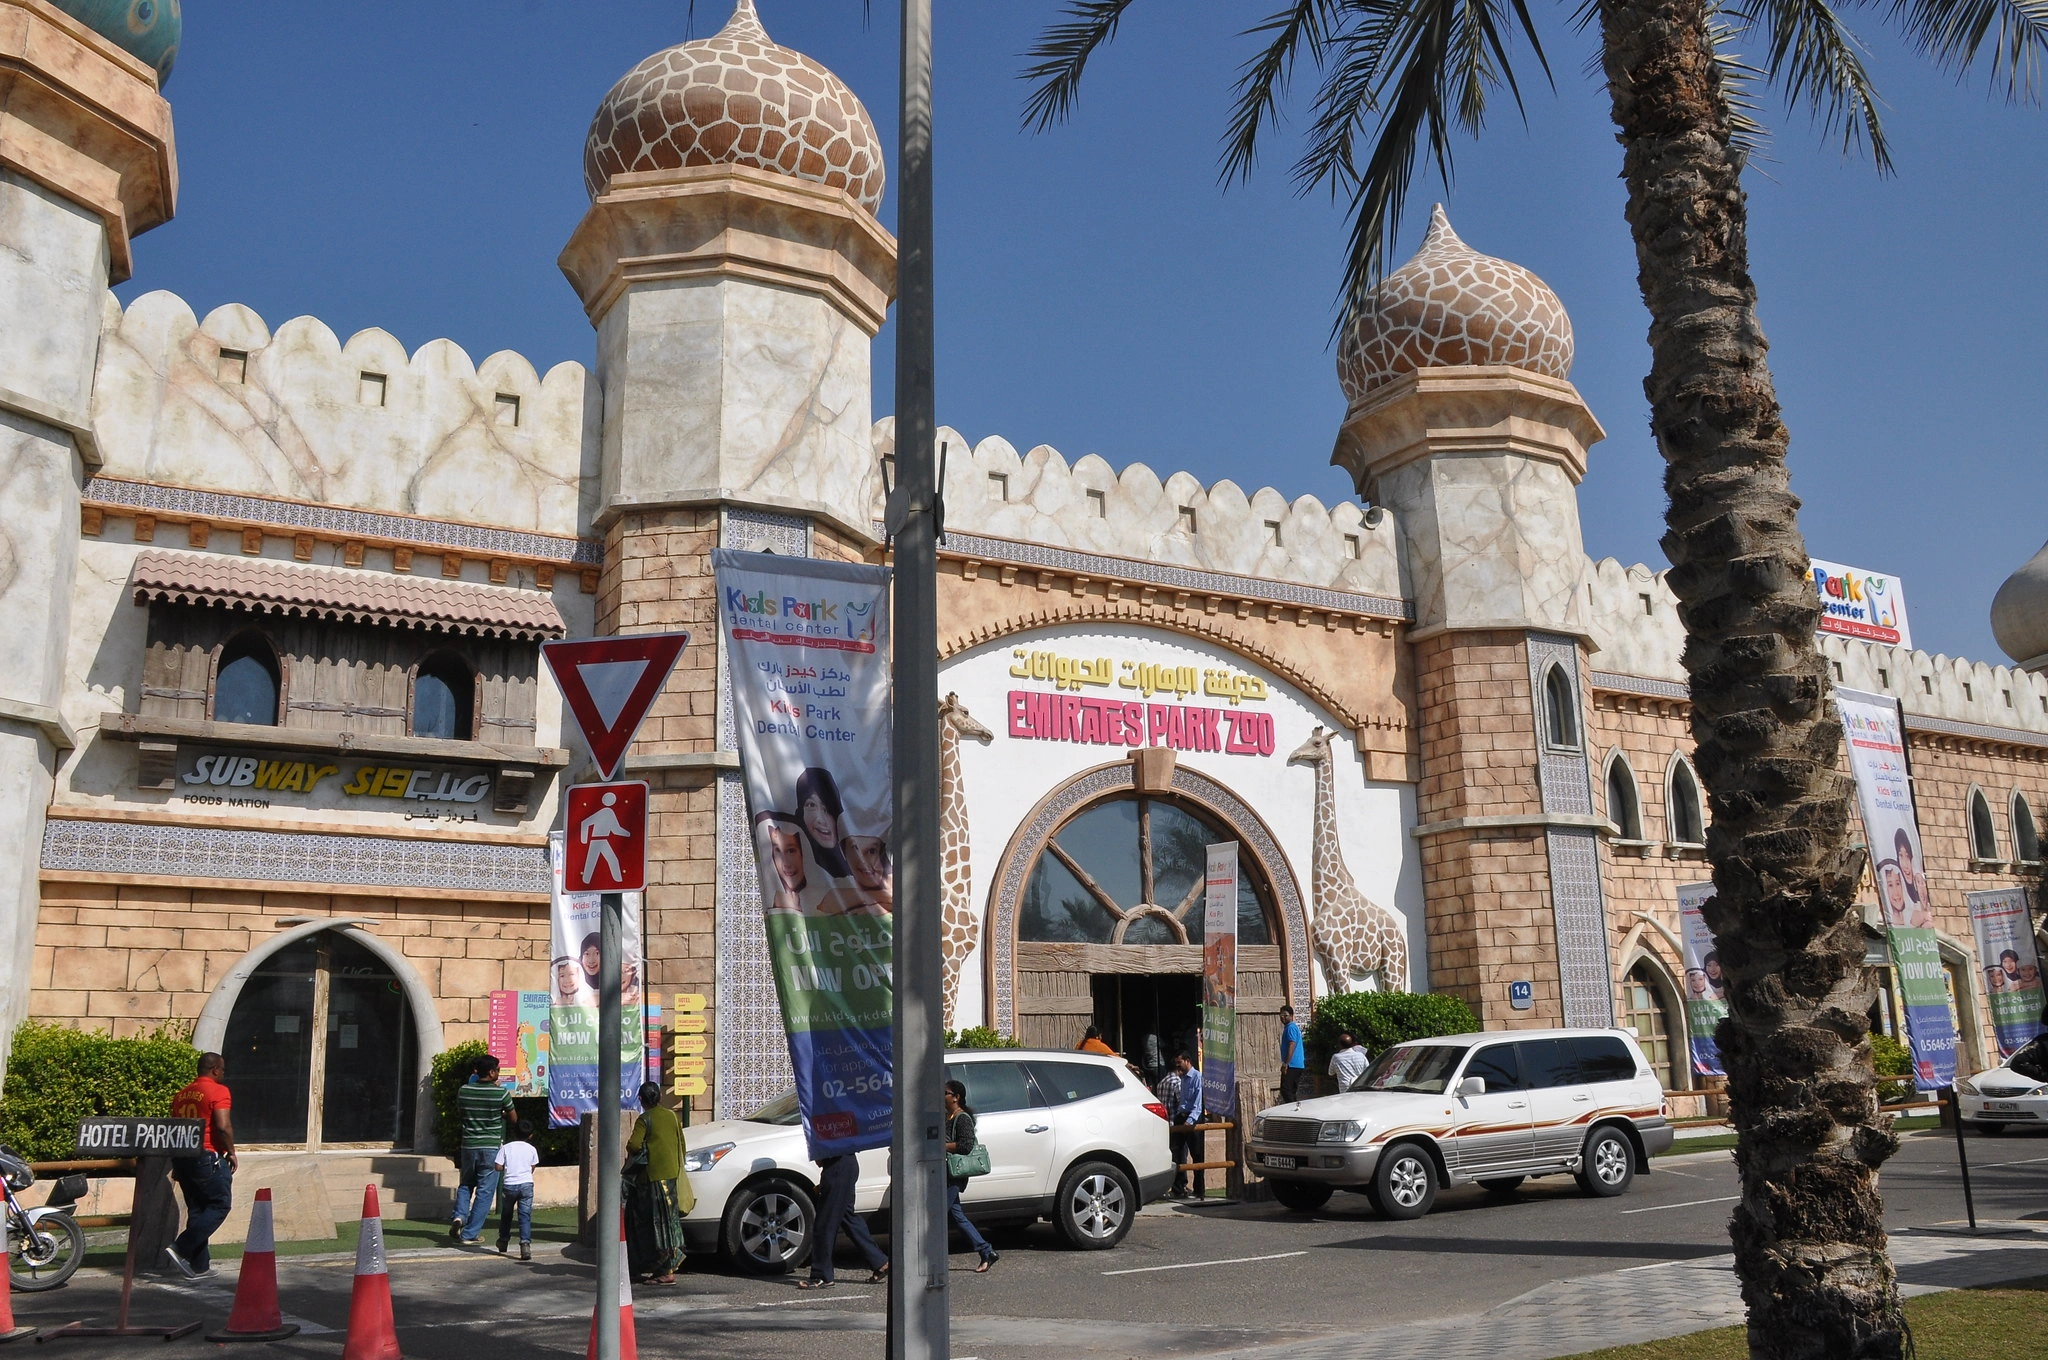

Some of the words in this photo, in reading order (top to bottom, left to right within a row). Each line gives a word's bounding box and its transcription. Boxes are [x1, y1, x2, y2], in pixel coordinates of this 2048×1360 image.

[1813, 568, 1863, 602] Park
[726, 586, 776, 616] Kids
[782, 596, 839, 621] Park
[729, 614, 776, 631] dental
[785, 621, 839, 635] center
[757, 660, 783, 675] بارك
[785, 665, 817, 678] كيدز
[819, 667, 851, 682] مركز
[1008, 649, 1113, 691] للحيوانات
[813, 687, 846, 698] لطب
[1203, 669, 1269, 704] حديقة
[806, 704, 841, 721] Park
[1007, 691, 1144, 747] EMIRATES
[1147, 704, 1223, 752] PARK
[1223, 710, 1276, 756] ZOO
[805, 724, 856, 743] Center
[182, 755, 339, 793] SUBWAY
[183, 794, 222, 807] FOODS
[228, 797, 270, 809] NATION
[573, 902, 590, 910] Kids
[591, 901, 600, 909] Pa
[1514, 985, 1529, 996] 14
[1996, 1005, 2017, 1015] NOW
[1694, 1016, 1716, 1025] NOW
[557, 1031, 591, 1045] NOW
[79, 1124, 130, 1148] HOTEL
[135, 1124, 200, 1149] PARKING
